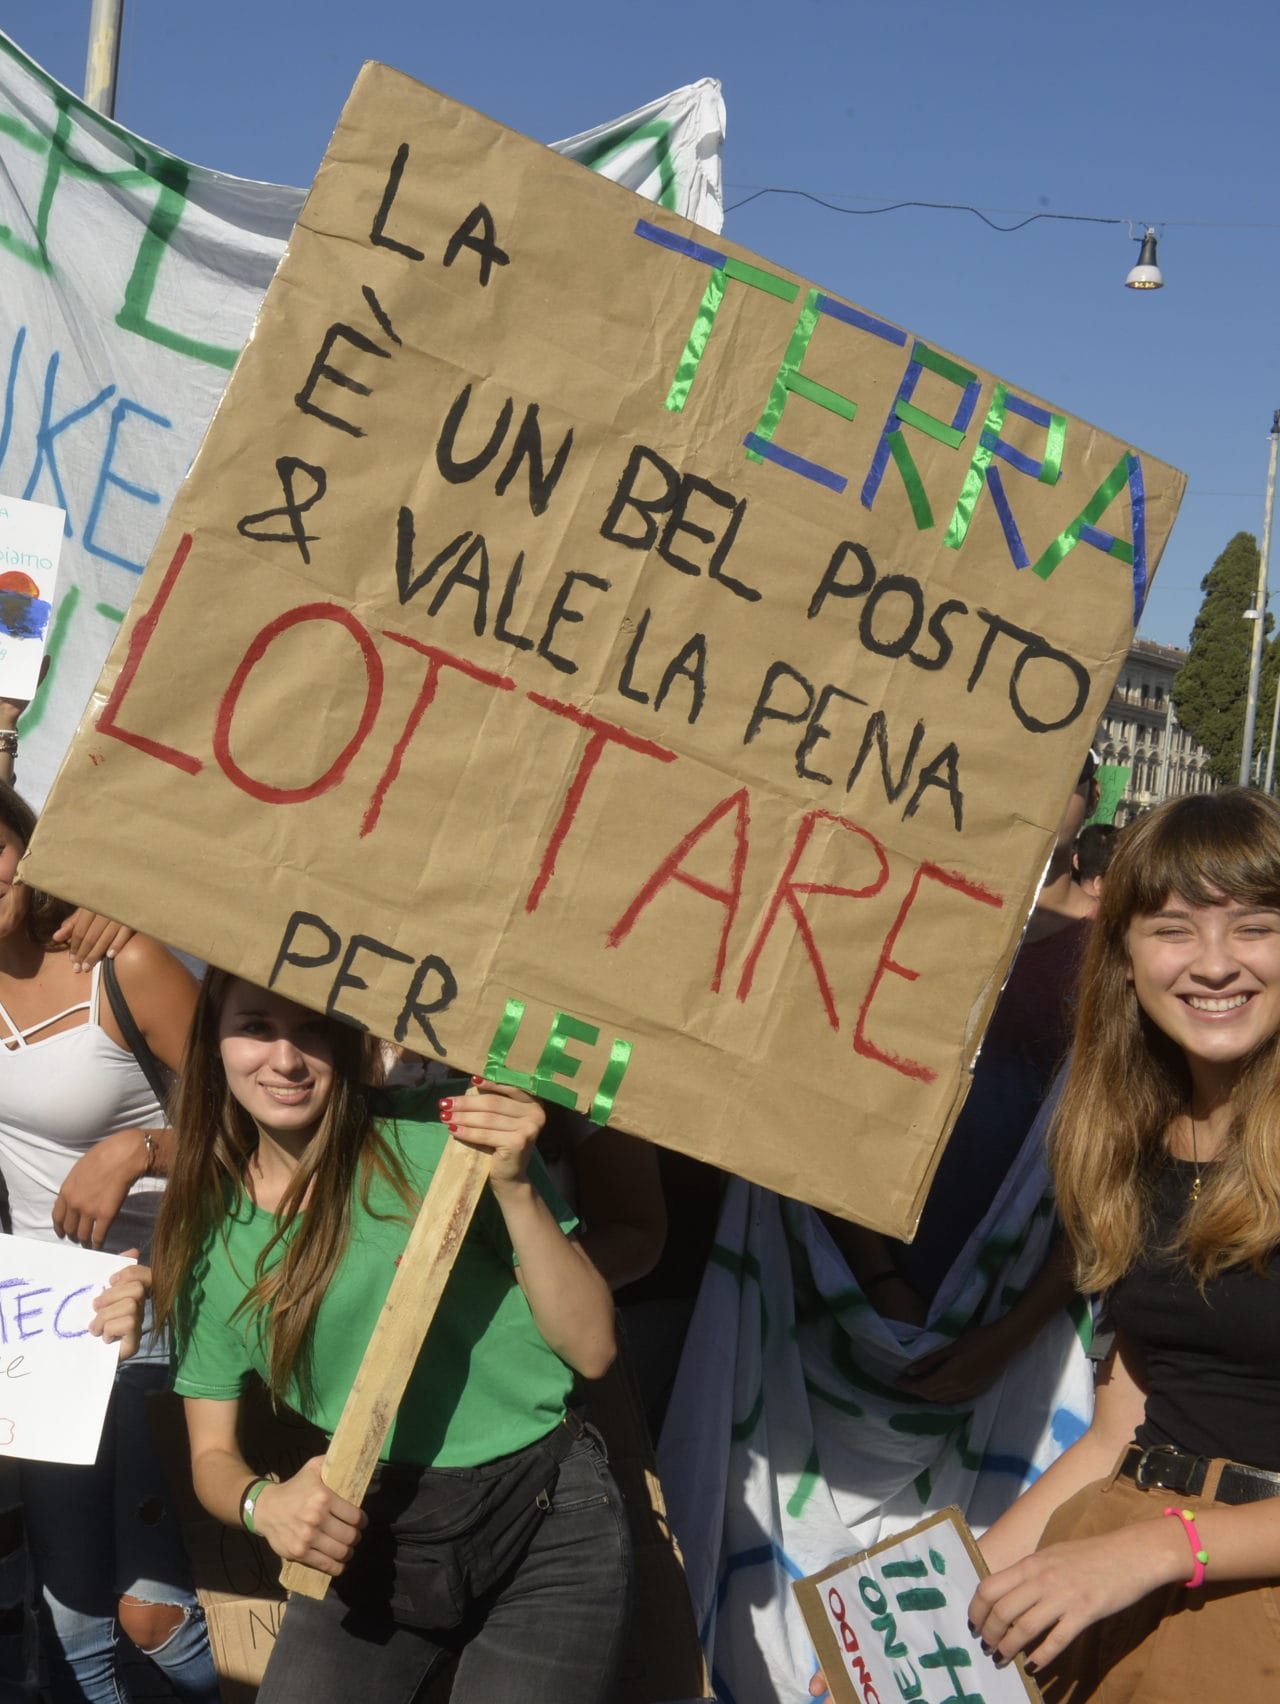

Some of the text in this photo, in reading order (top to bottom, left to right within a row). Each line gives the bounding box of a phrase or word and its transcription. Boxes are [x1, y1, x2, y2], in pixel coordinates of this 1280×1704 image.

[368, 142, 511, 287] LA
[633, 218, 1148, 628] TERRA
[435, 383, 575, 517] UN
[600, 444, 763, 602] BEL
[807, 540, 1091, 733] POSTO
[95, 532, 1004, 1084] LOTTARE
[236, 455, 328, 565] &
[395, 506, 613, 675] VALE
[618, 607, 708, 724] LA
[743, 660, 963, 832] PENA
[267, 910, 634, 1127] PER LEI
